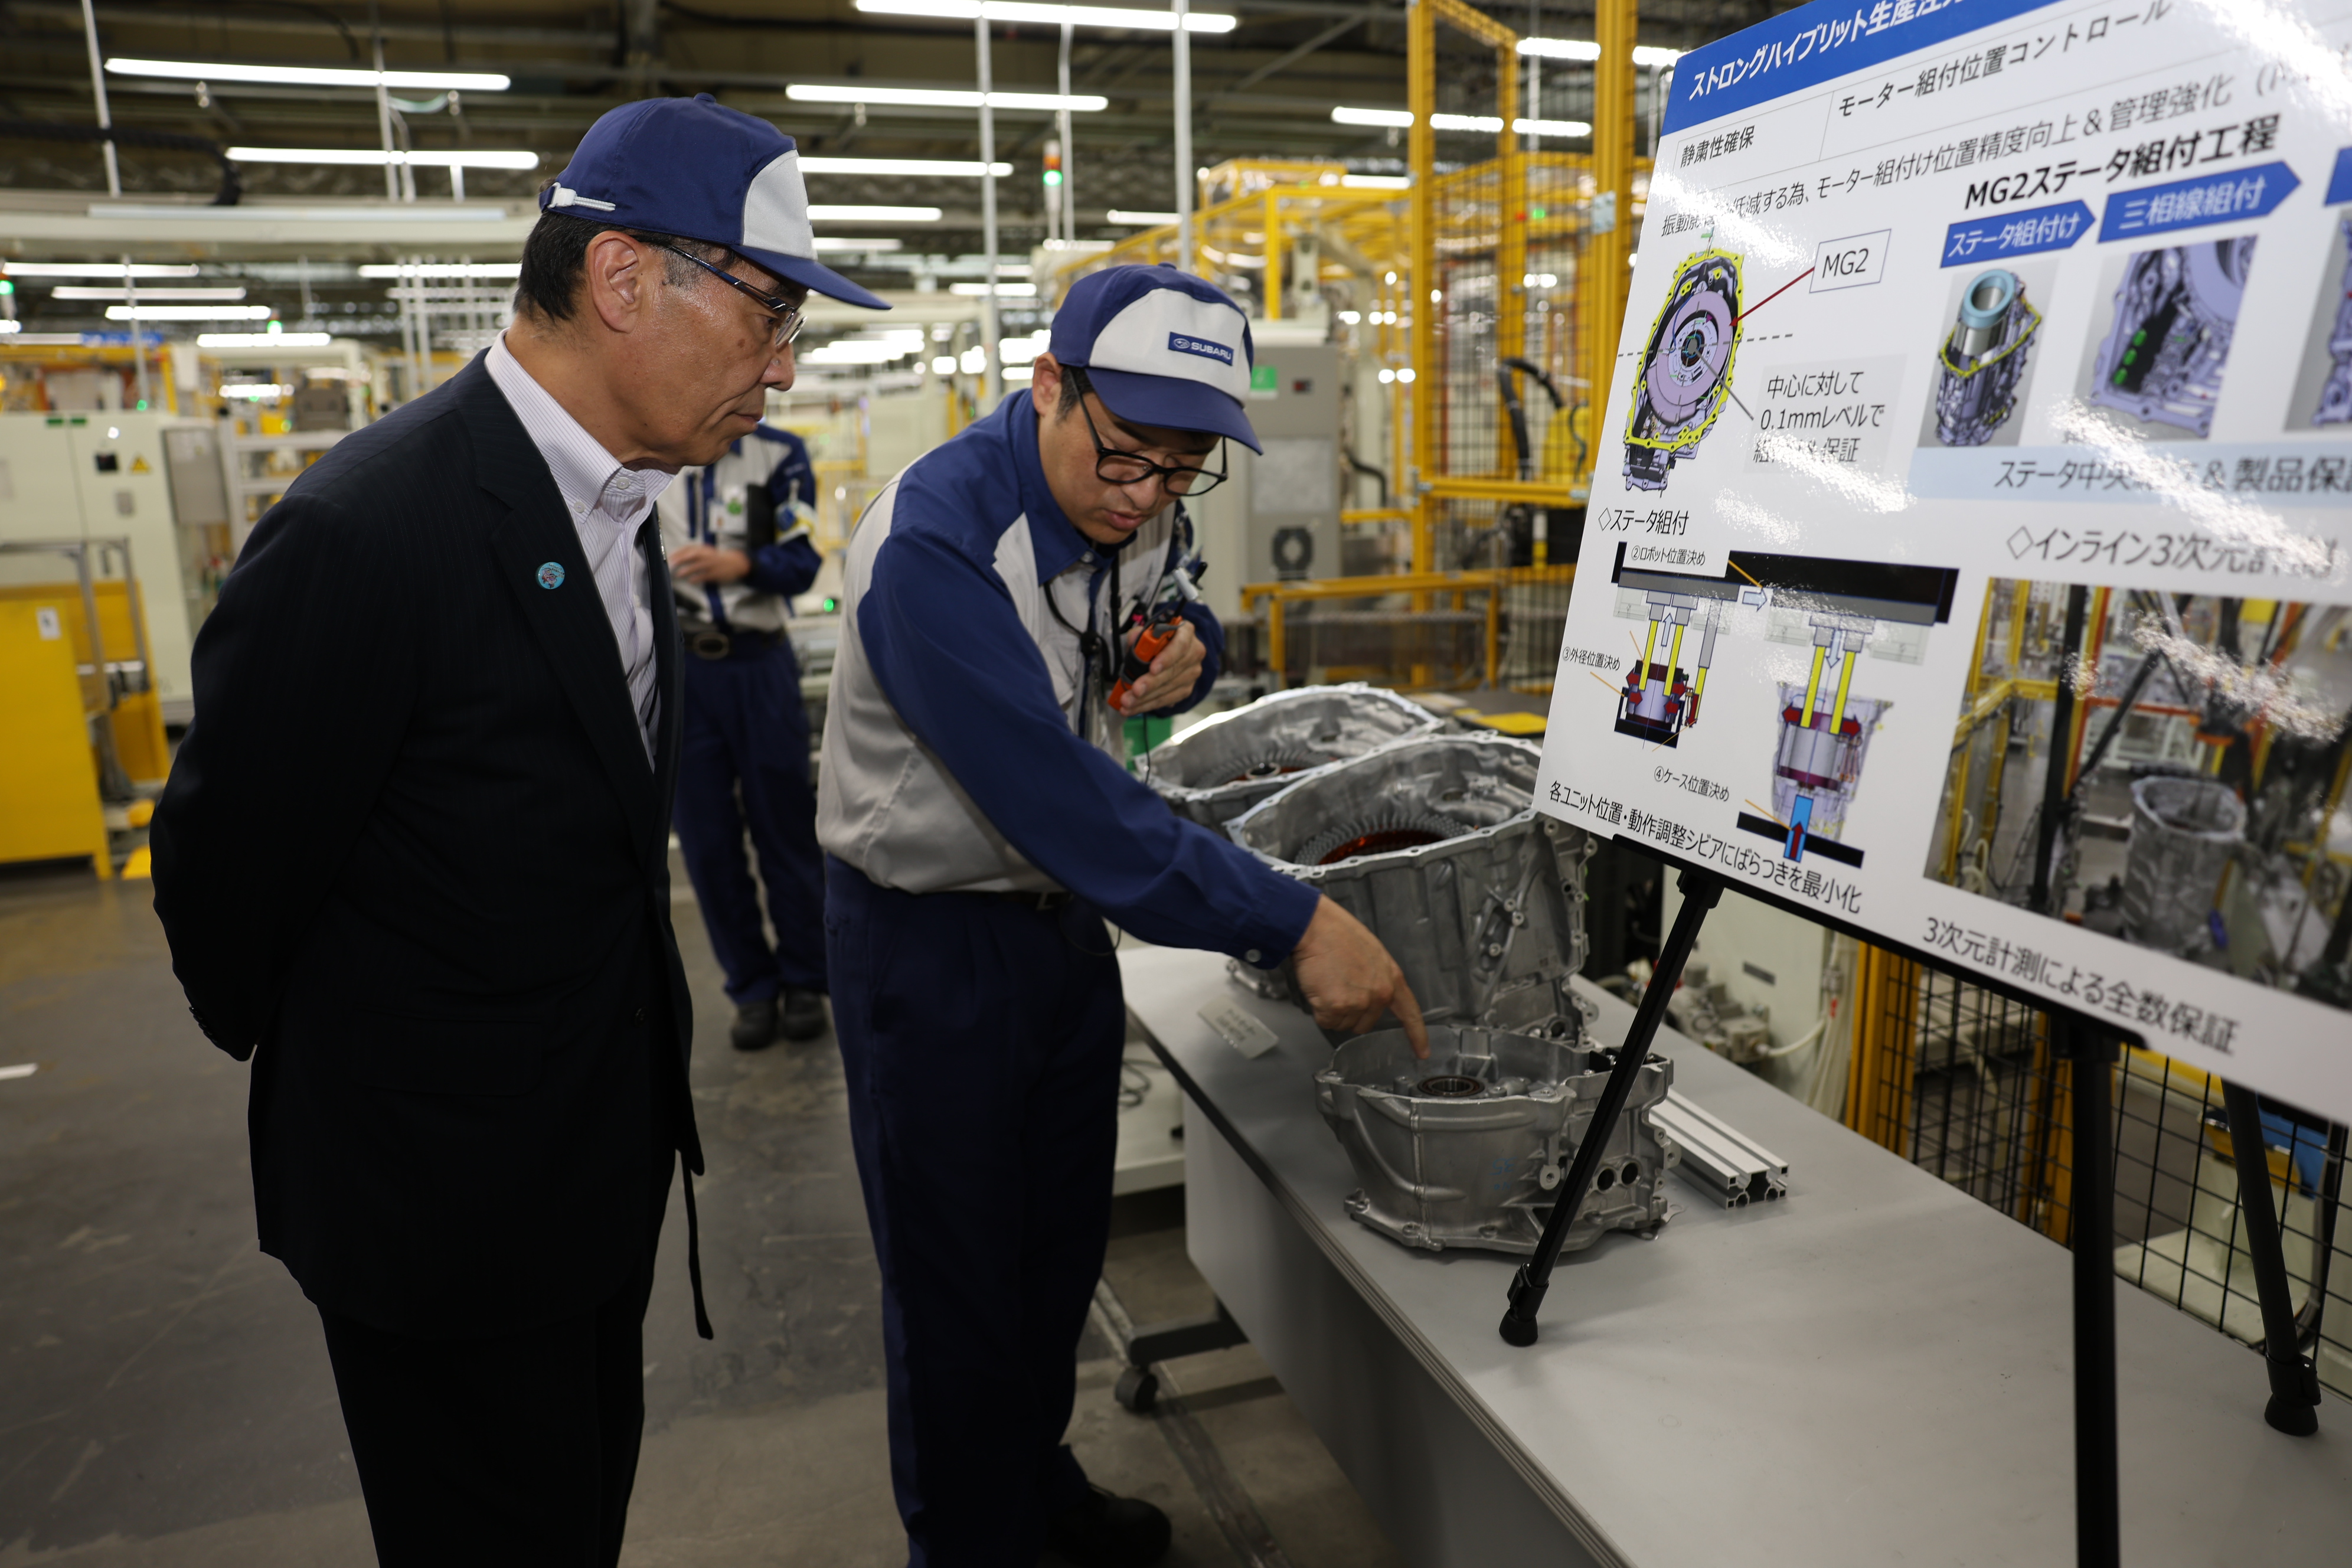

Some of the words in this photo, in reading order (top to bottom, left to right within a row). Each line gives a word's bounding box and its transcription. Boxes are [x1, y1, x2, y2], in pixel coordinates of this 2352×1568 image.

[1680, 125, 1755, 168] 静粛性確保
[1964, 113, 2280, 210] MG2ステータ組付工程
[2119, 175, 2266, 230] 三相線組付
[1948, 213, 2080, 257] ステータ組付け
[1822, 248, 1869, 279] MG2
[1191, 341, 1231, 360] SUBARU
[1768, 370, 1864, 400] 中心に対して
[1760, 403, 1885, 430] 0.1mmレベルで
[1922, 915, 2242, 1057] 3次元計測による全数保証
